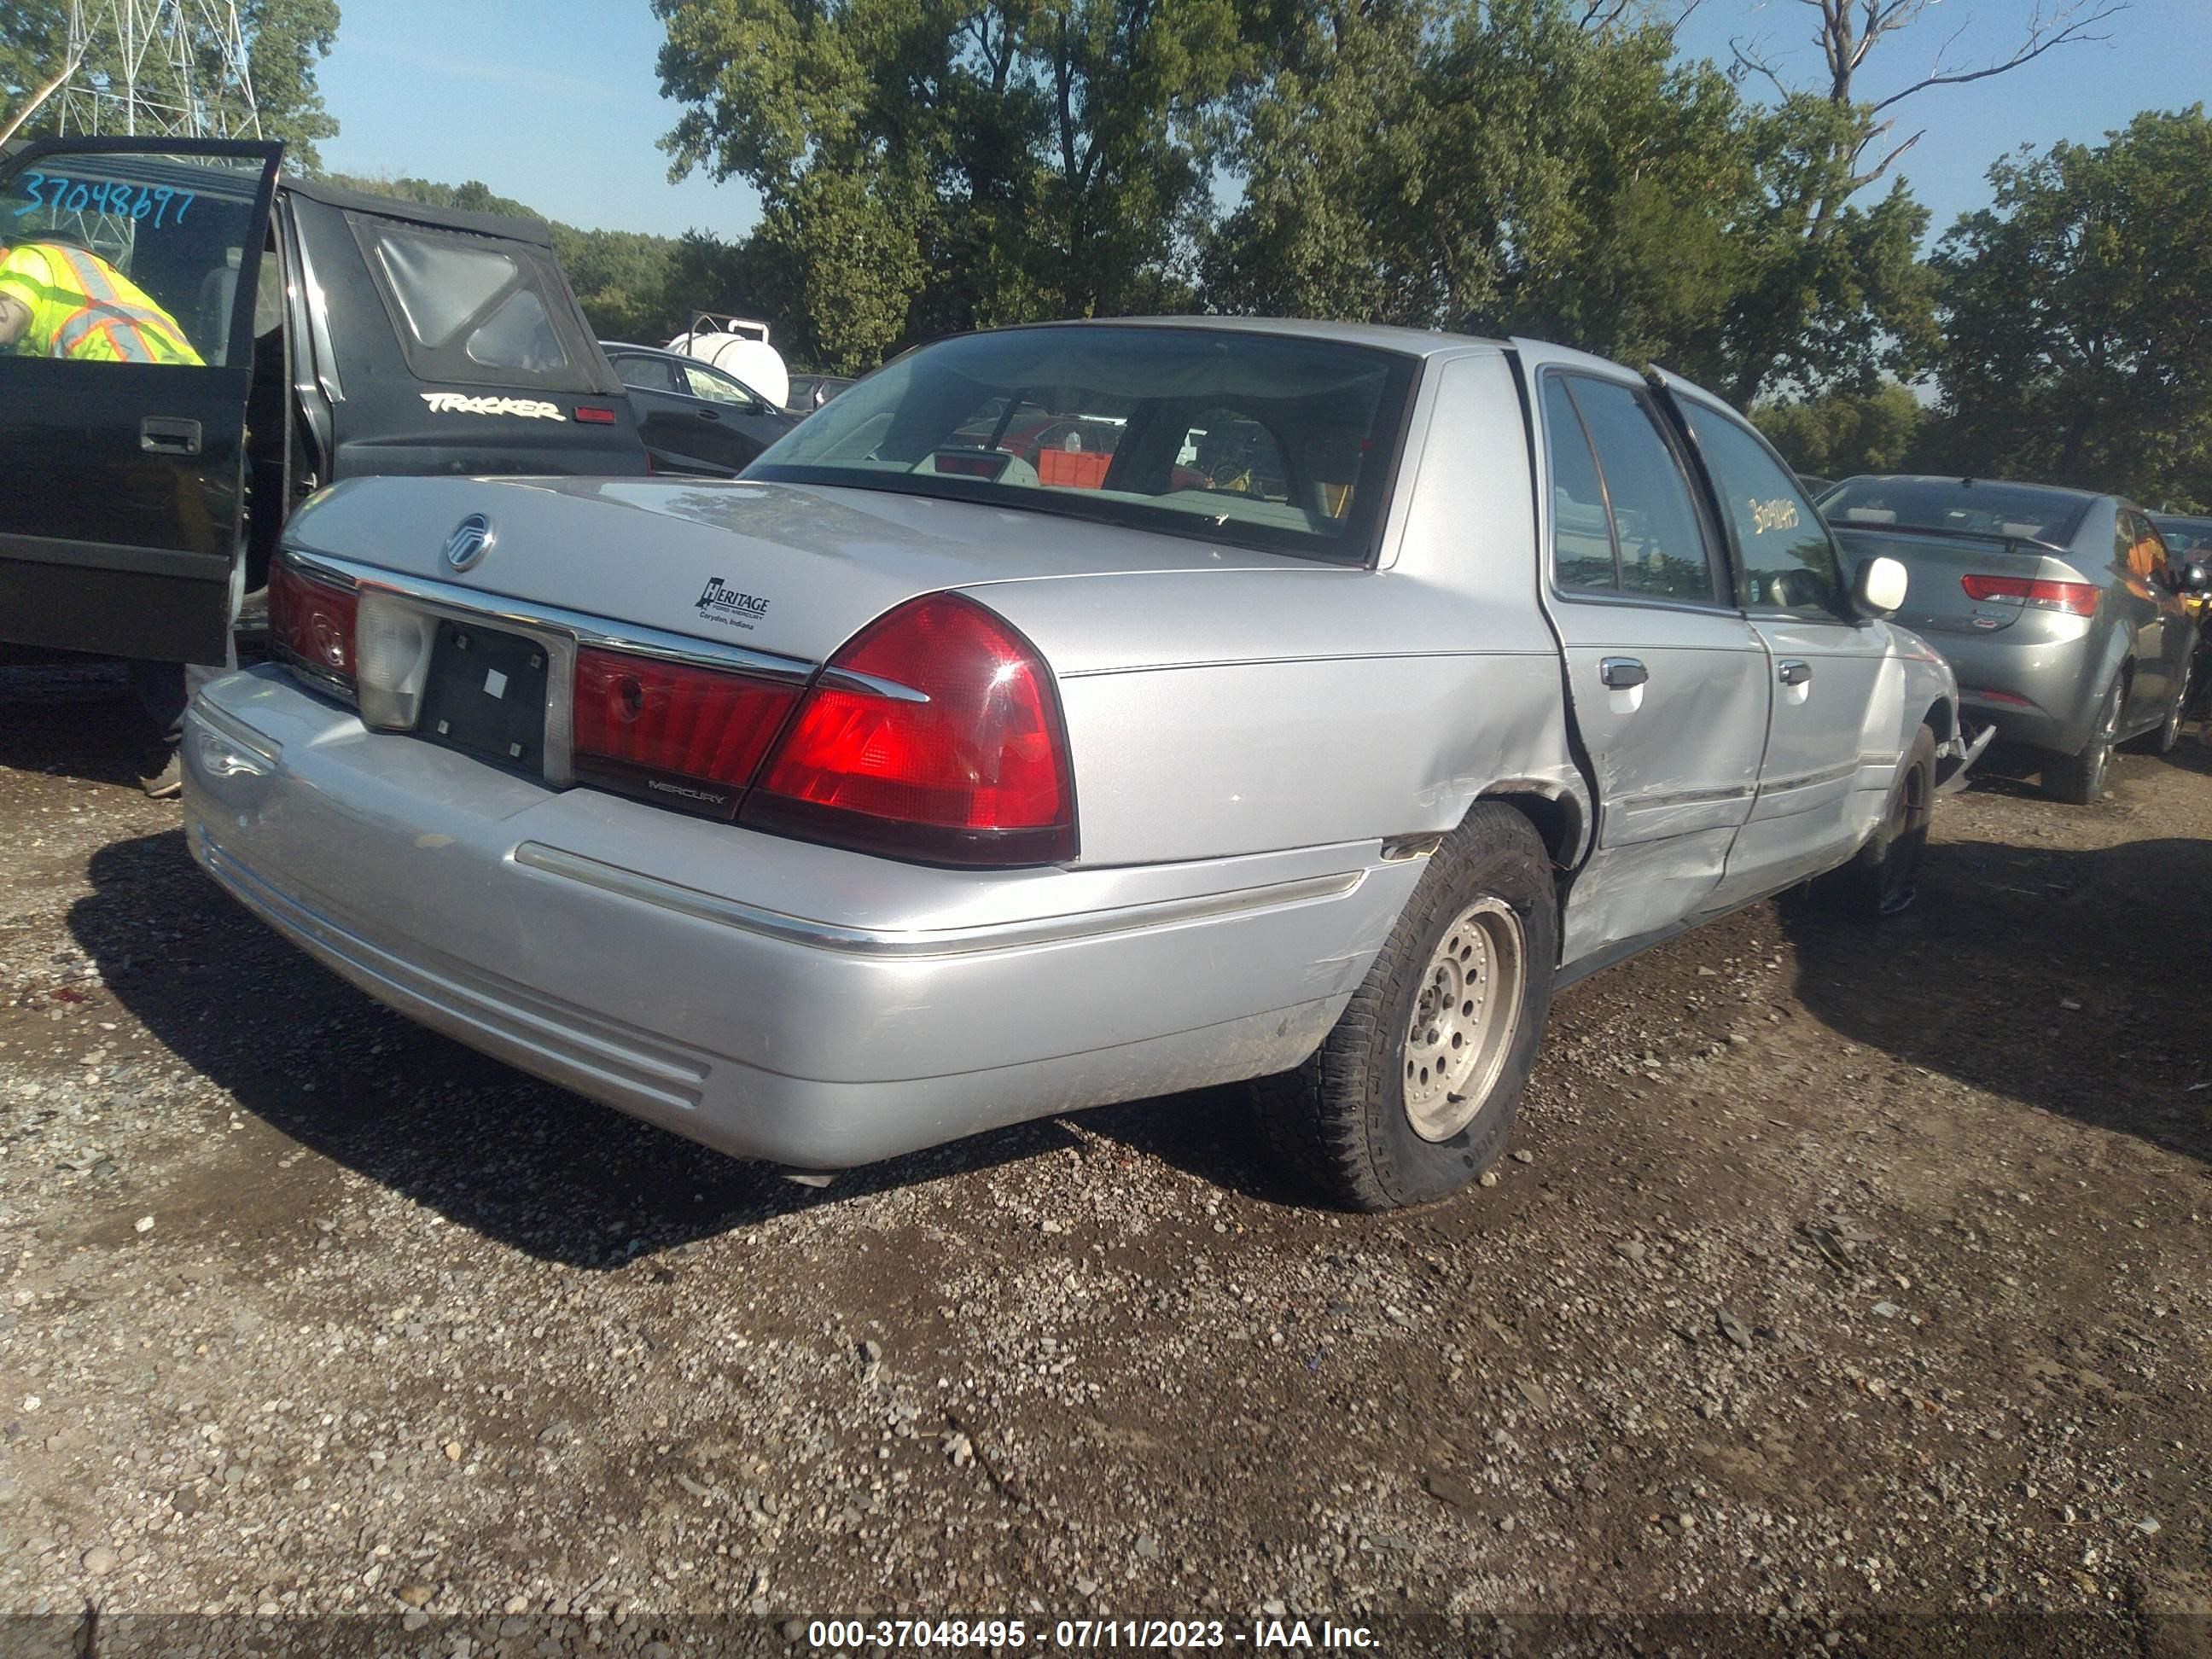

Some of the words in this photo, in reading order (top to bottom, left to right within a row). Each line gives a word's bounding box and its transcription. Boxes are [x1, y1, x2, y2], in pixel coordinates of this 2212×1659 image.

[14, 170, 195, 229] 37048697
[419, 393, 567, 422] TRACKER
[699, 577, 770, 613] HERITAGE
[729, 619, 754, 630] Indiana
[649, 779, 727, 805] MERCURY
